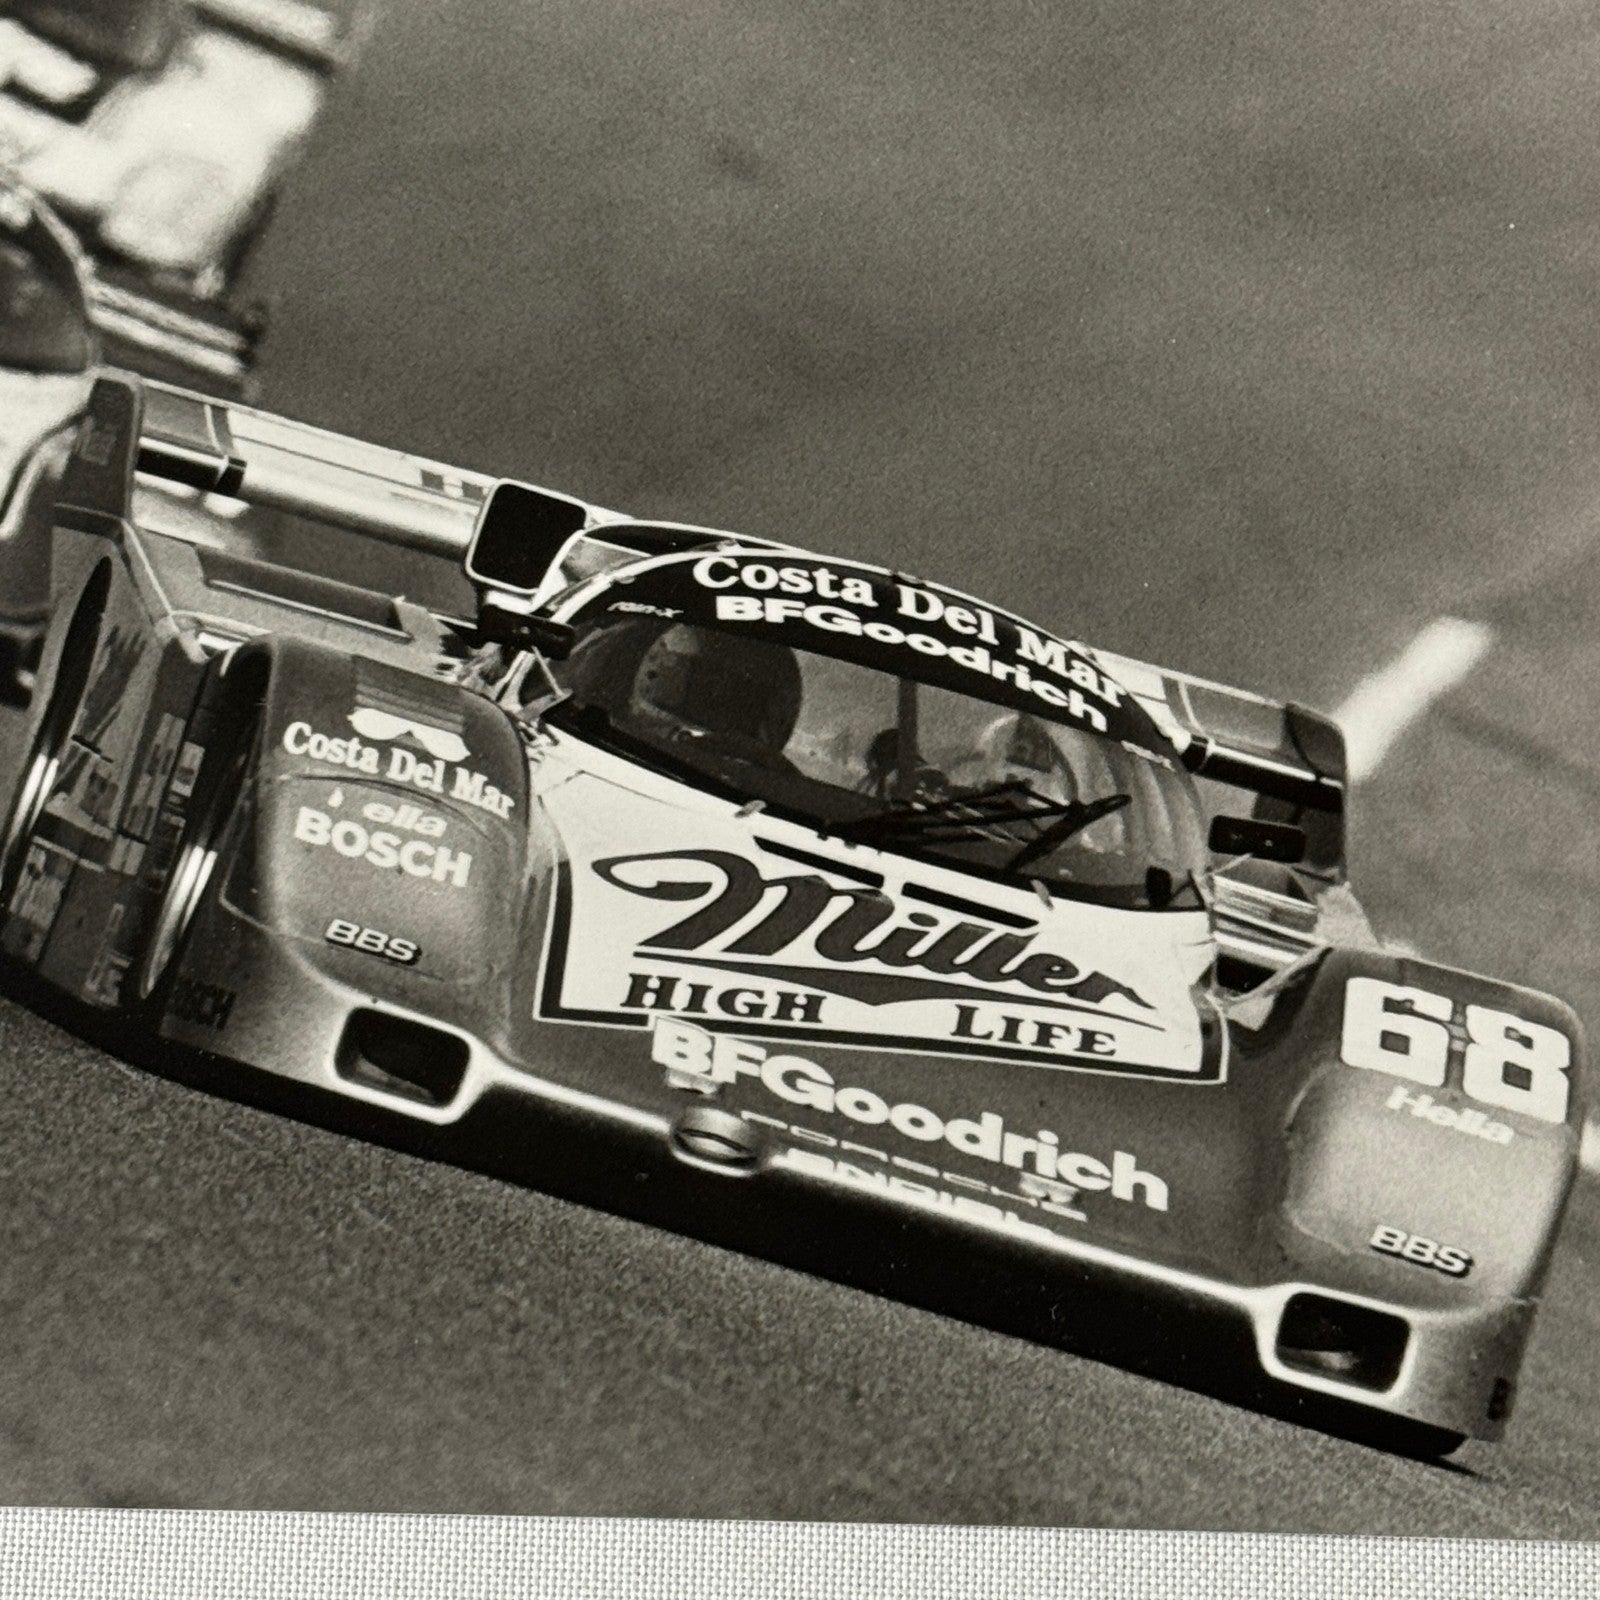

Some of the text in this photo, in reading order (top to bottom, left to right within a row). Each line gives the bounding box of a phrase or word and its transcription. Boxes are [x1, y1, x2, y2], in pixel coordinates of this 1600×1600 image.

[692, 556, 1127, 708] Costa Del Mar
[715, 595, 1108, 732] BFGoodrich
[283, 721, 515, 819] Costa Del Mar
[294, 806, 473, 887] BOSCH
[325, 918, 419, 962] BBS
[590, 848, 1158, 1010] Miller
[620, 972, 1117, 1057] HIGH LIFE
[1340, 976, 1571, 1125] 68
[651, 1016, 1169, 1212] BFGoodrich
[1385, 1086, 1516, 1145] Hella
[1369, 1224, 1471, 1274] BBS
